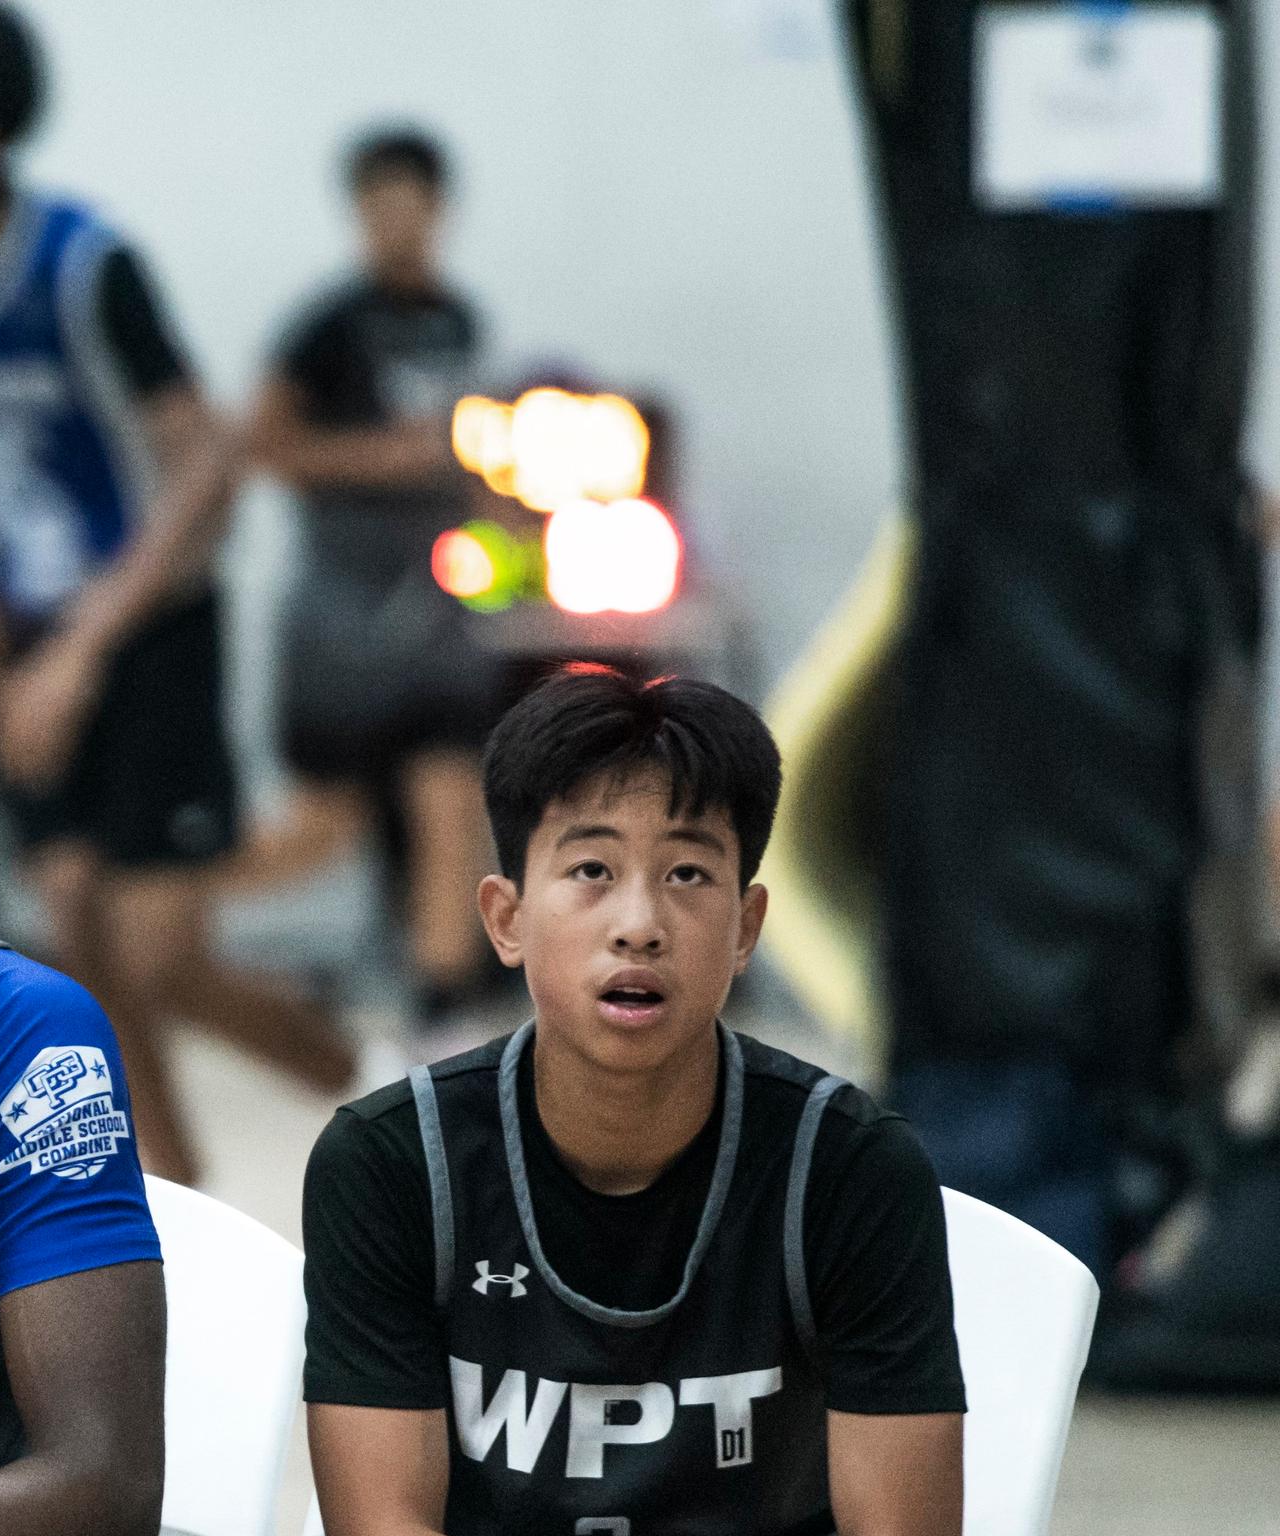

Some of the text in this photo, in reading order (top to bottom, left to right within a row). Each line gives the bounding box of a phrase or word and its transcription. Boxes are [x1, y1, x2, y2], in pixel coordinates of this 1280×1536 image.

[77, 1116, 126, 1138] SCHOOL
[39, 1136, 113, 1168] COMBINE
[448, 1355, 783, 1479] WPT
[720, 1427, 746, 1463] D1
